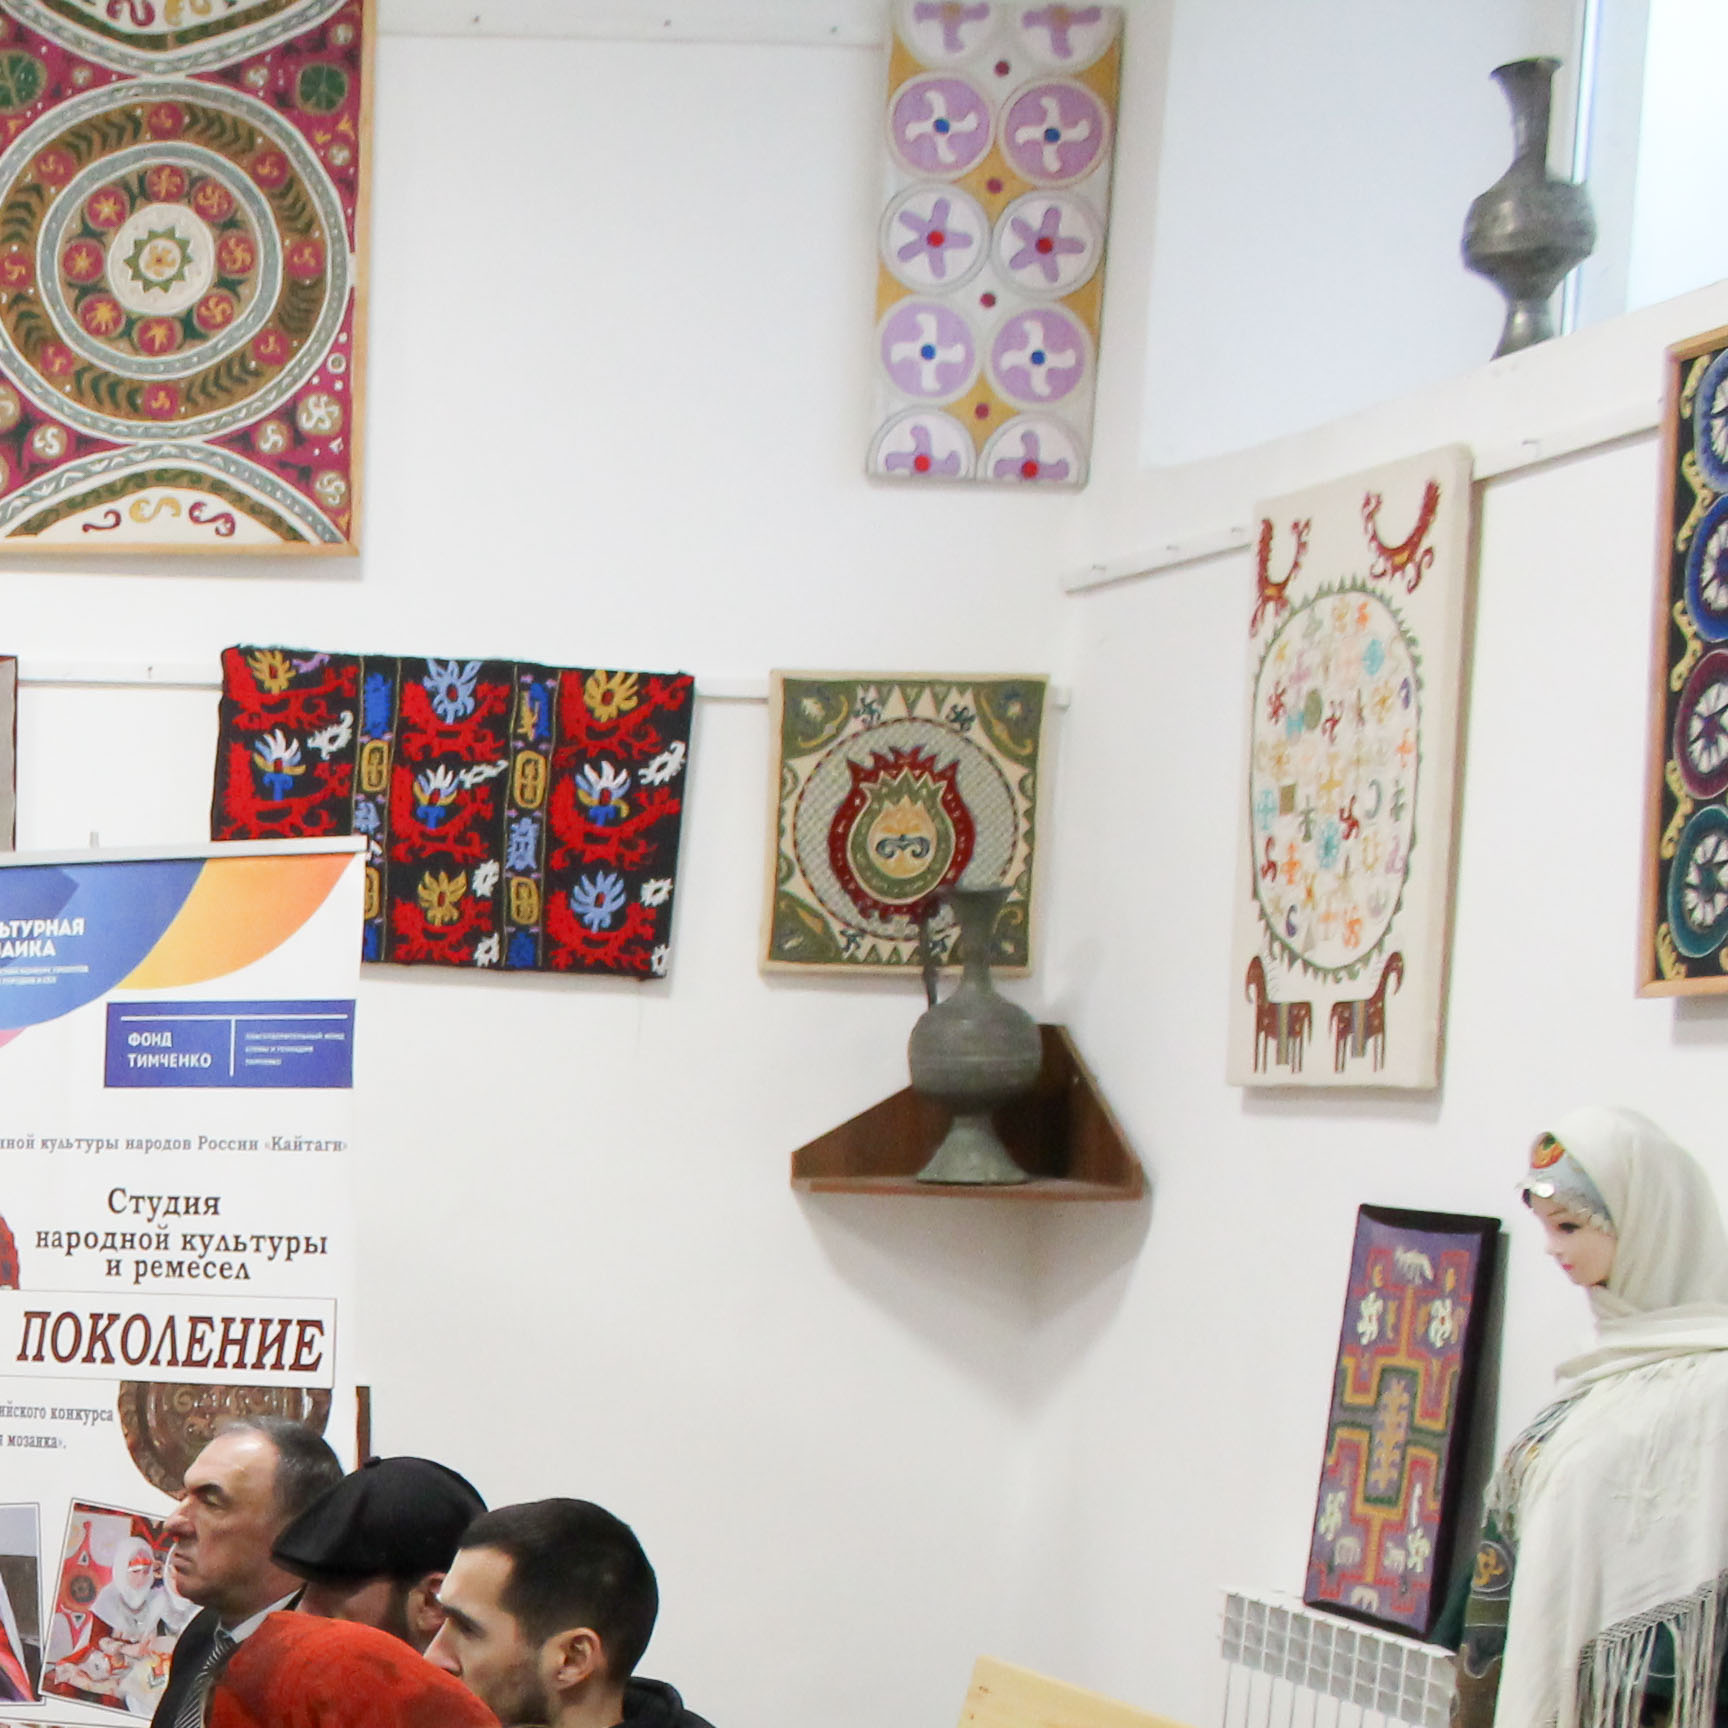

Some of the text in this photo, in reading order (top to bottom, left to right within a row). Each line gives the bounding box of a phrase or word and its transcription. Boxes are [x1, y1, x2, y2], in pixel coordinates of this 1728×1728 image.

[127, 1031, 172, 1048] ФОНД
[127, 1053, 212, 1069] ТИМЧЕНКО
[40, 1136, 118, 1155] культуры
[125, 1137, 192, 1155] народов
[197, 1135, 259, 1152] России
[107, 1187, 220, 1224] Студия
[35, 1223, 328, 1263] народной культуры
[105, 1258, 251, 1285] и ремесел
[16, 1310, 326, 1372] ПОКОЛЕНИЕ
[50, 1406, 114, 1425] конкурса
